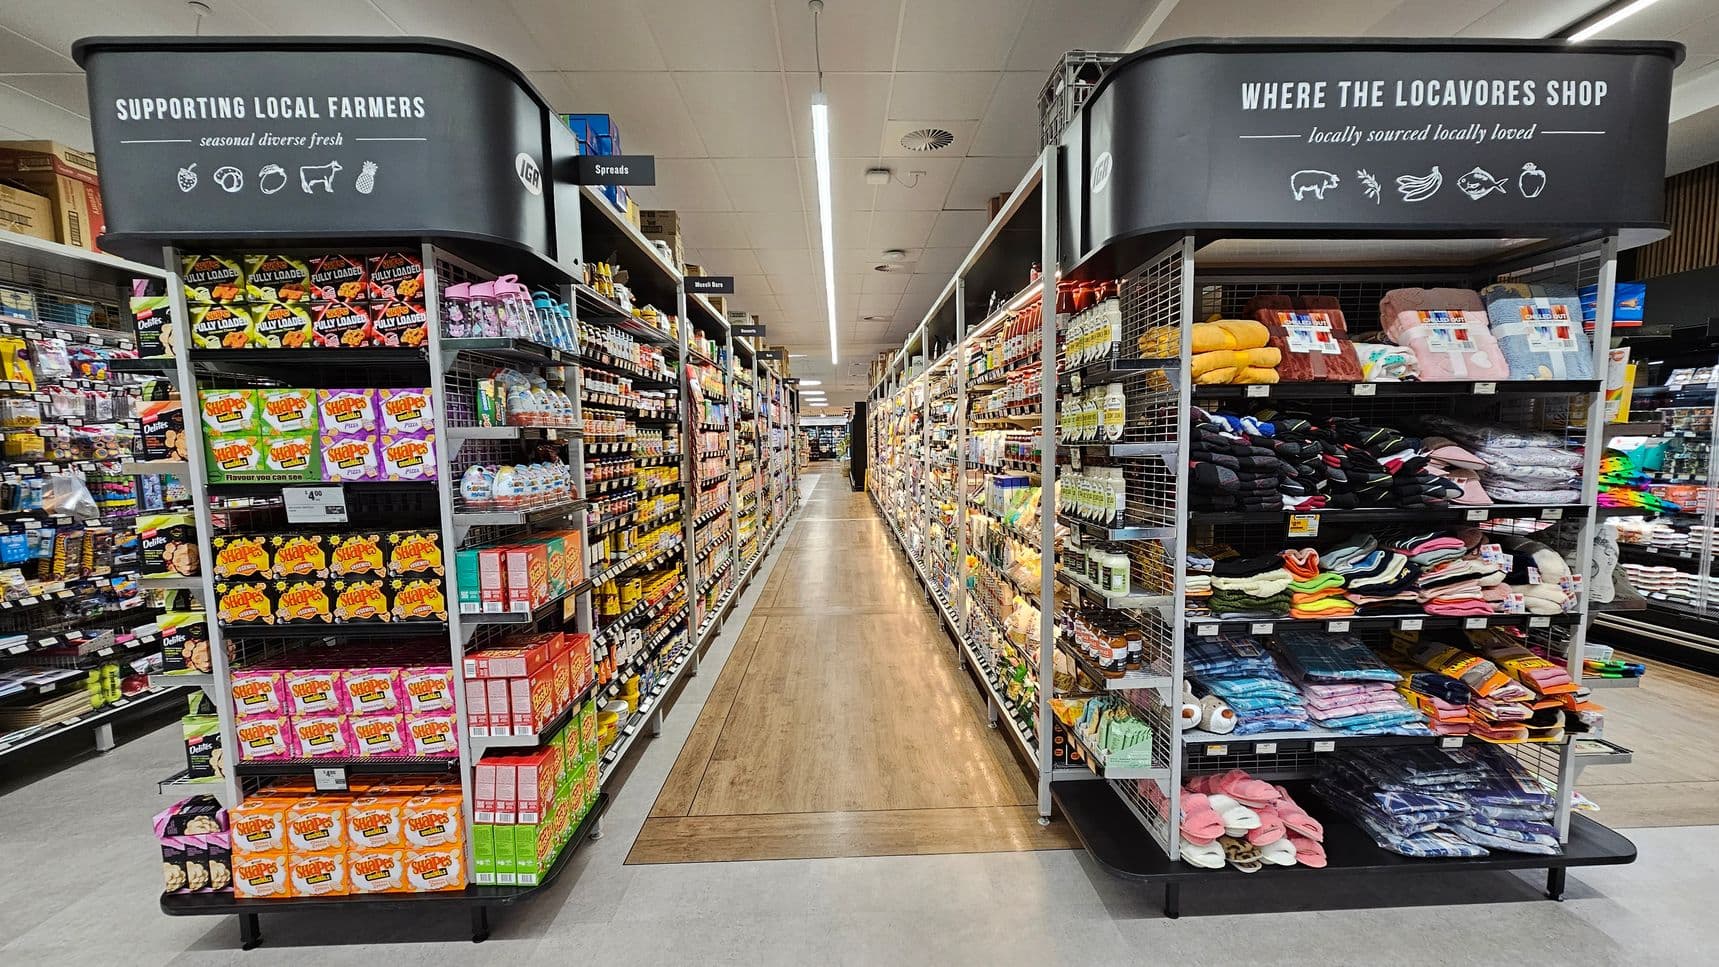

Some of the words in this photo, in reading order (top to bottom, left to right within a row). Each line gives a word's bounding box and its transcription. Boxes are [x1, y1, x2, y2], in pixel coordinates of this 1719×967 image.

[1241, 81, 1327, 110] WHERE
[1338, 80, 1385, 107] THE
[1395, 79, 1536, 107] LOCAVORES
[1546, 80, 1608, 106] SHOP
[115, 96, 246, 121] SUPPORTING
[254, 97, 320, 119] LOCAL
[328, 96, 426, 119] FARMERS
[199, 133, 255, 147] seasonal
[258, 132, 307, 147] diverse
[307, 132, 343, 148] fresh
[1307, 125, 1363, 146] locally
[1366, 124, 1432, 143] sourced
[1433, 123, 1487, 144] locally
[1491, 123, 1538, 141] loved
[519, 159, 540, 189] IGA
[595, 164, 629, 176] Spreads
[256, 474, 271, 482] you
